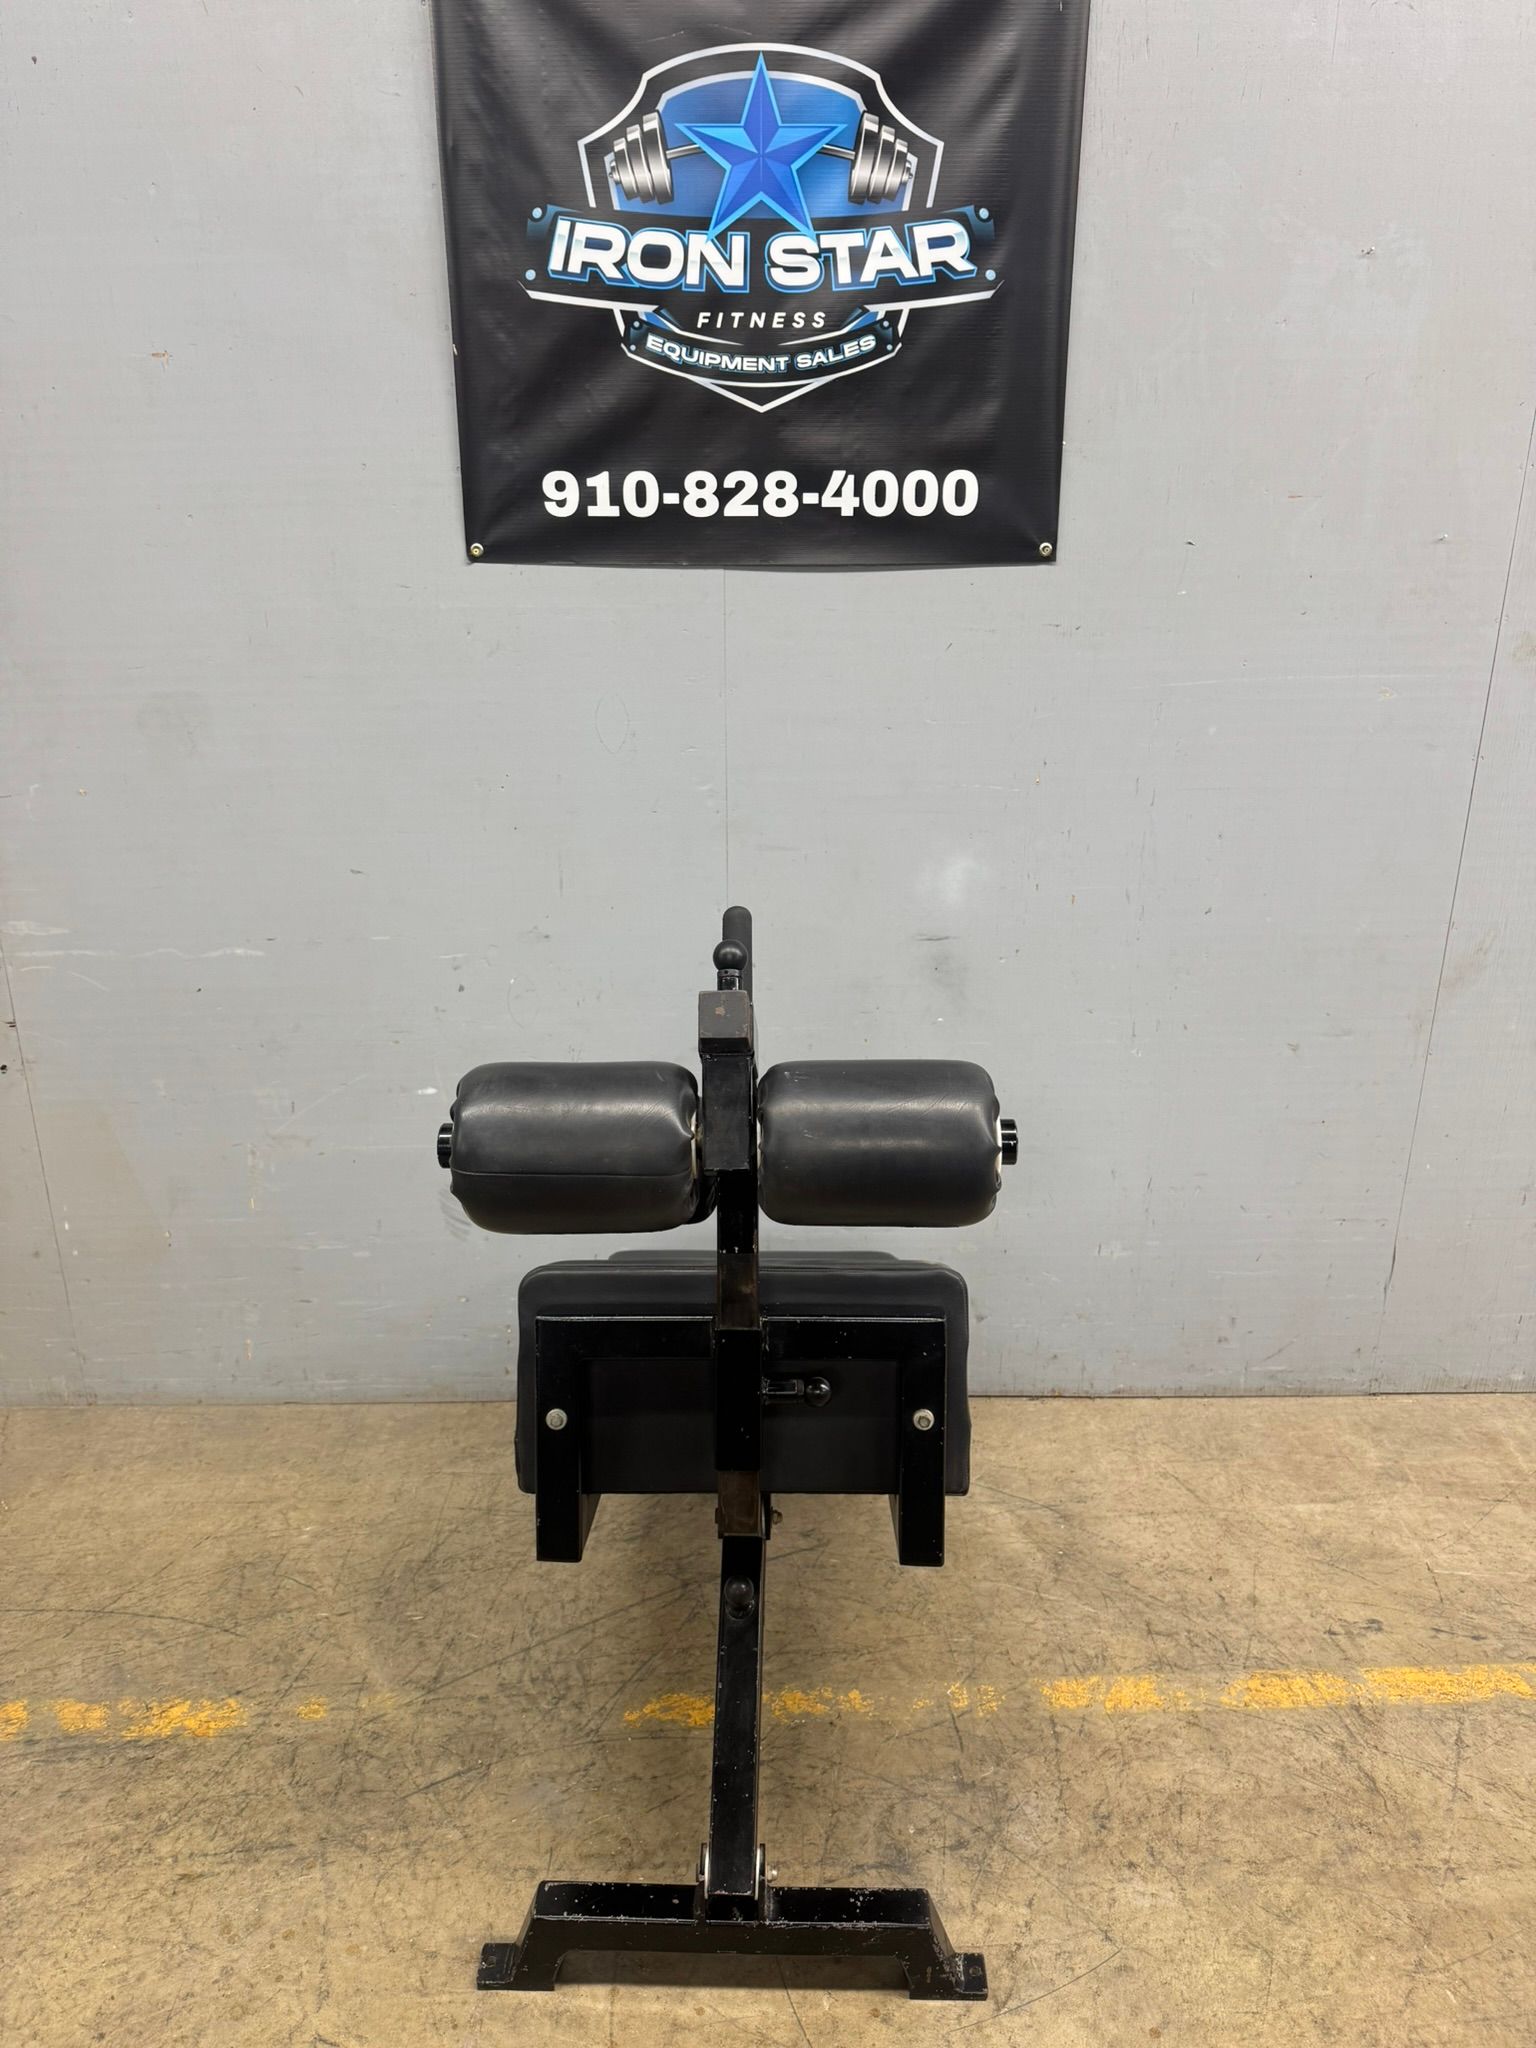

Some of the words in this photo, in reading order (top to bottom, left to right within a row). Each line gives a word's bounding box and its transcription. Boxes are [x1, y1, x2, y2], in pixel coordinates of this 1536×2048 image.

[548, 216, 749, 291] IRON
[765, 220, 976, 291] STAR
[696, 311, 827, 329] FITNESS
[646, 335, 788, 372] EQUIPMENT
[796, 335, 877, 369] SALES
[541, 470, 979, 518] 910-828-4000
